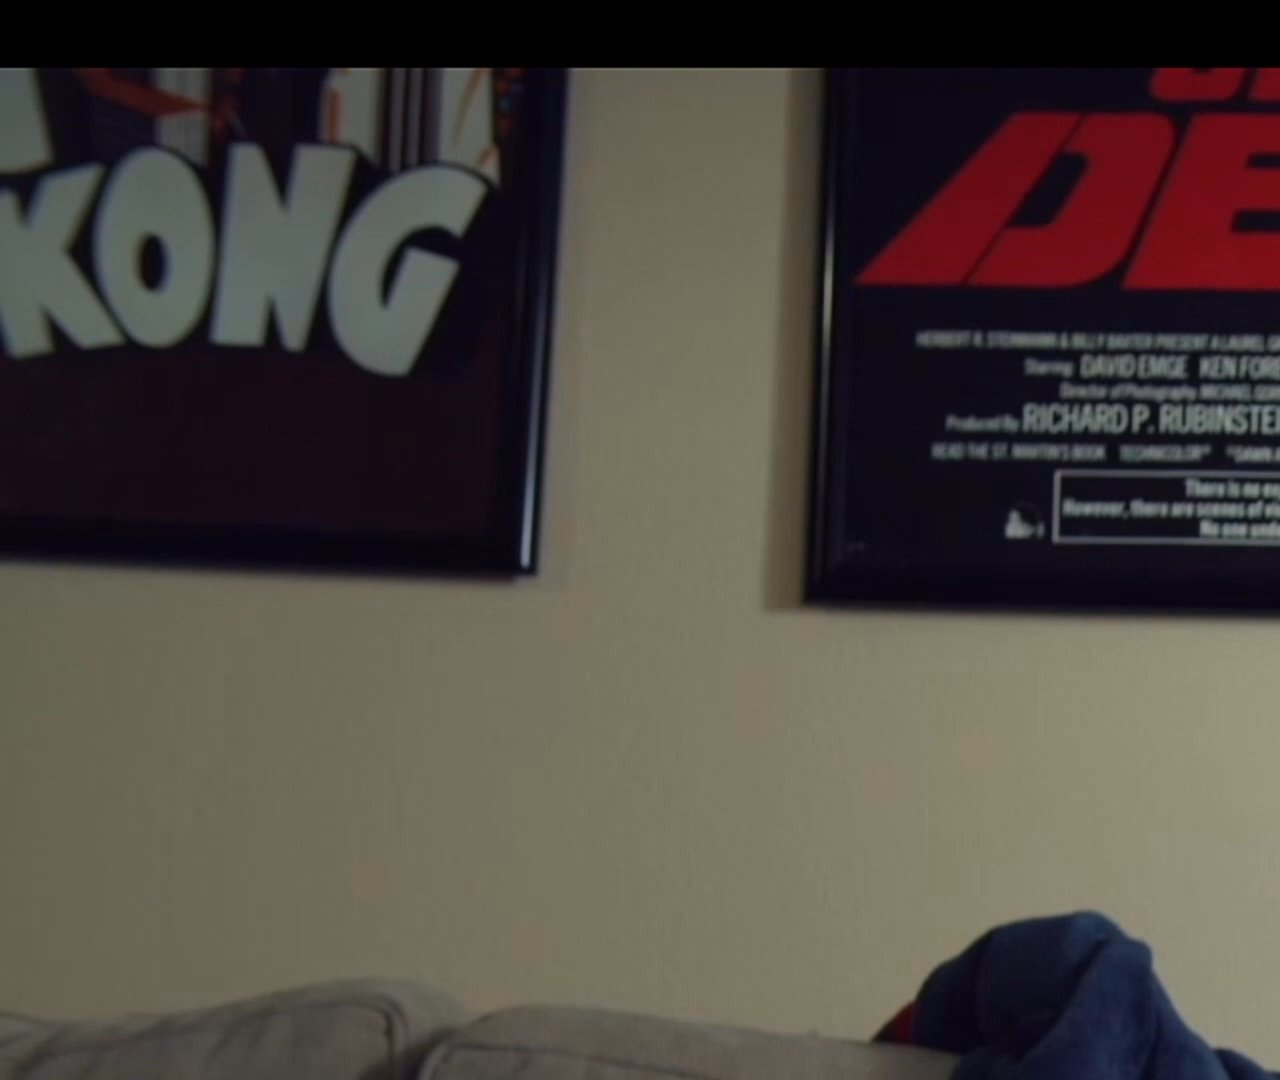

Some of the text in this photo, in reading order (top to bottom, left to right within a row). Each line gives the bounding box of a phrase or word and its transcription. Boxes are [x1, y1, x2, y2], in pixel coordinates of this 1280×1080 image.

[0, 142, 491, 377] KONG
[1080, 354, 1136, 378] DAVID
[1137, 355, 1189, 379] EMGE
[1199, 356, 1237, 380] KEN
[1022, 403, 1128, 433] RICHARD
[1131, 404, 1156, 434] P.
[1184, 478, 1225, 497] There
[1227, 480, 1241, 497] is
[1242, 484, 1260, 498] no
[1063, 499, 1129, 519] However,
[1130, 500, 1168, 518] there
[1170, 503, 1195, 518] are
[1196, 502, 1246, 518] scenes
[1199, 519, 1220, 538] No
[1221, 523, 1248, 538] one
